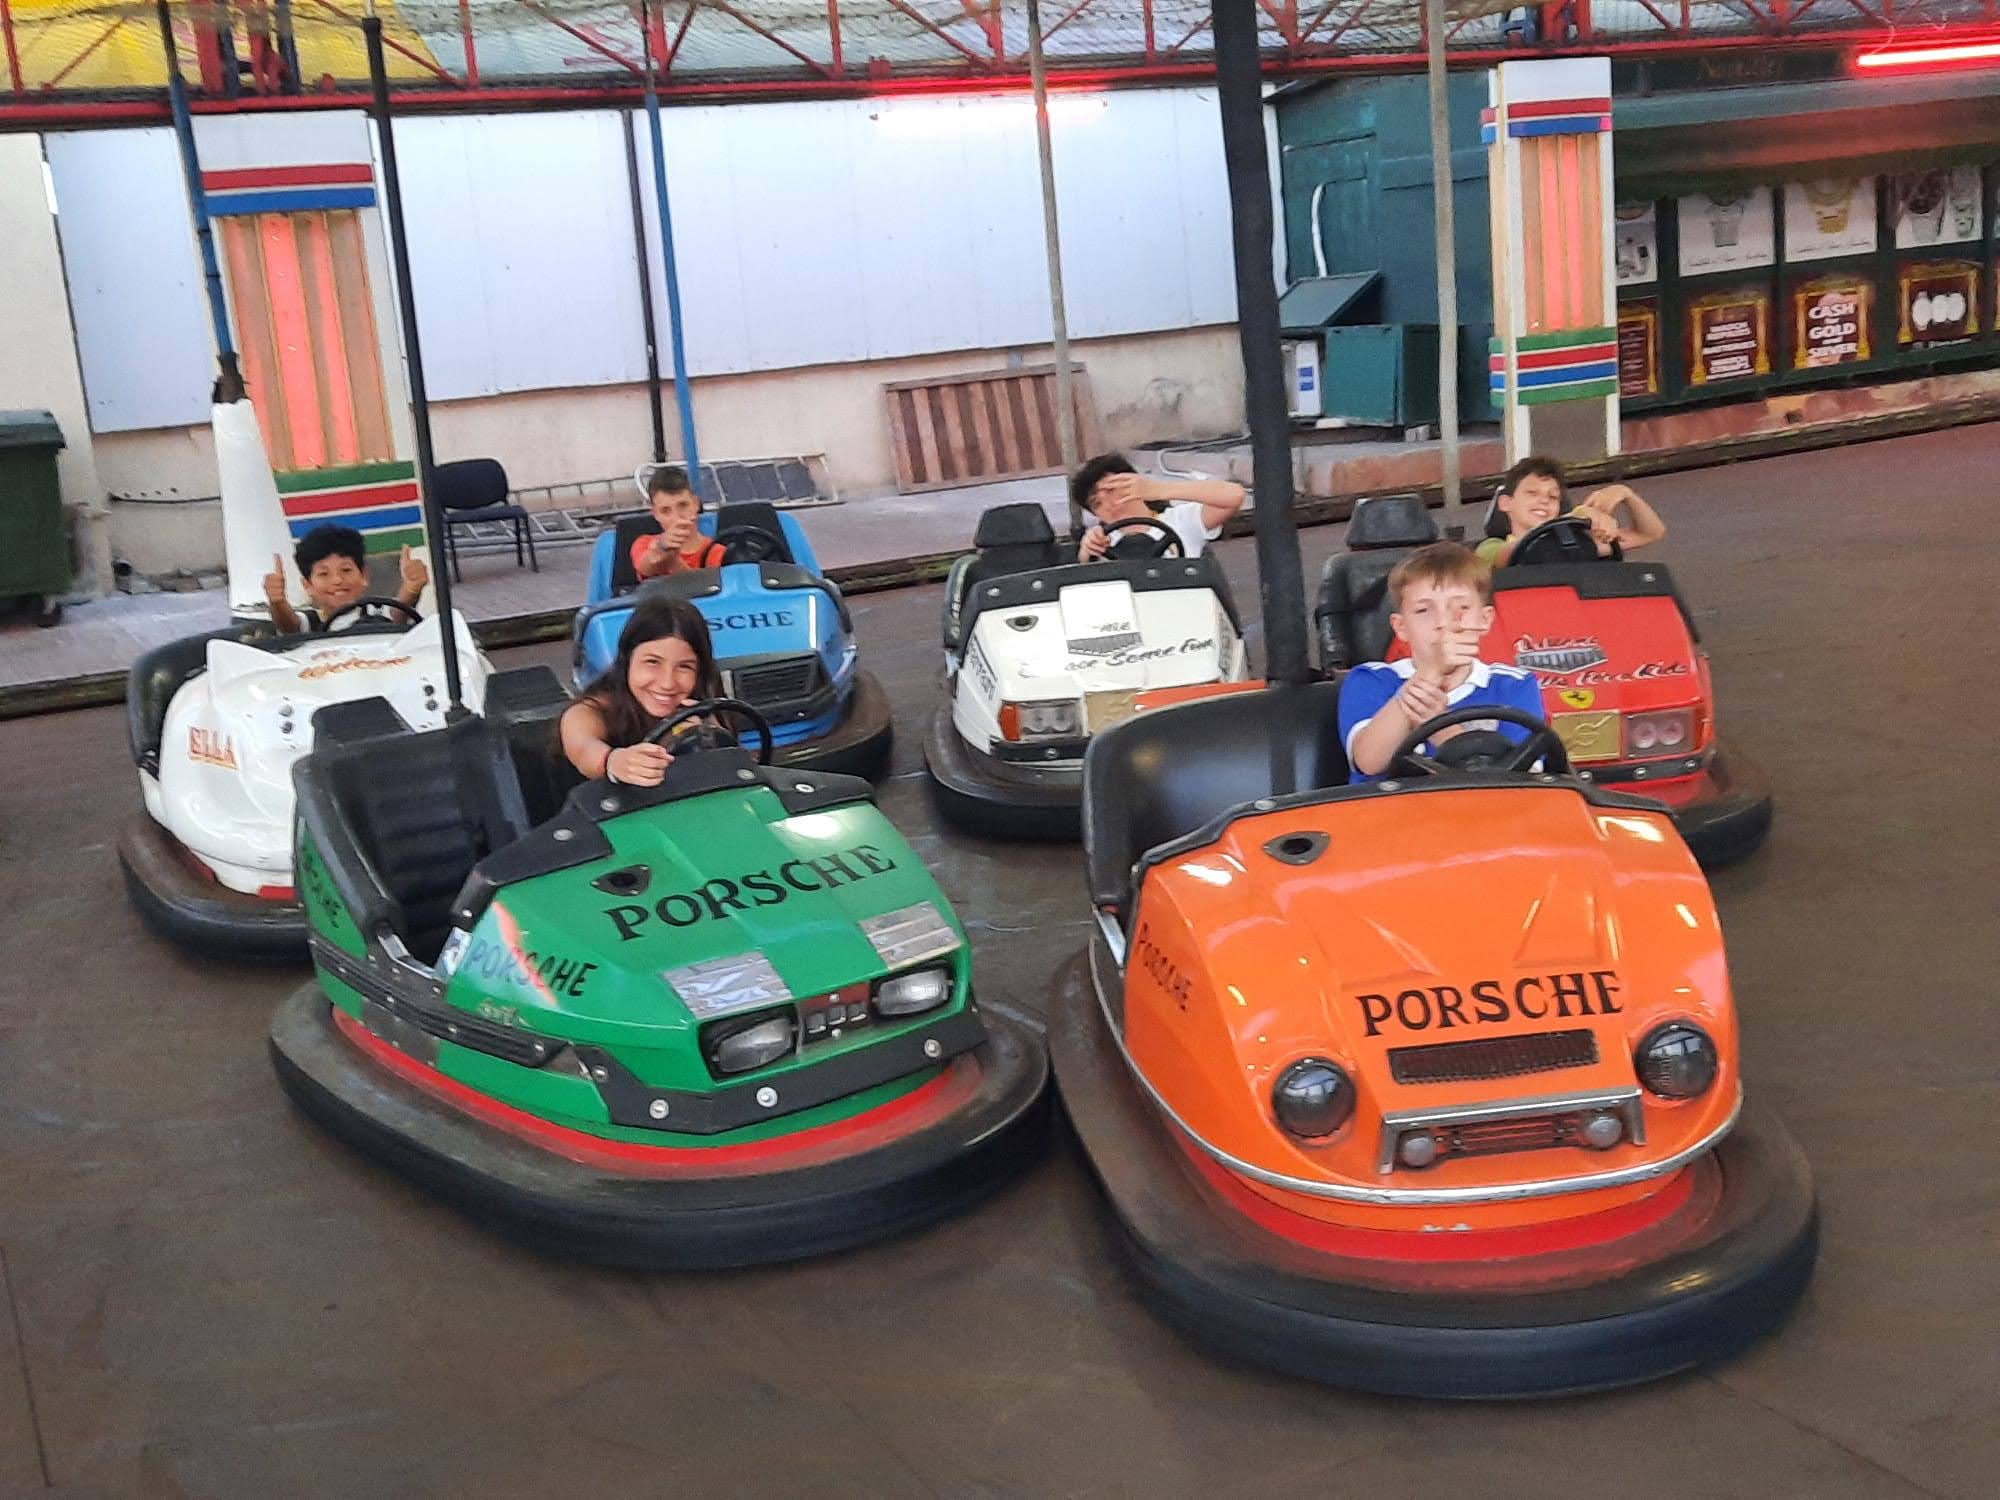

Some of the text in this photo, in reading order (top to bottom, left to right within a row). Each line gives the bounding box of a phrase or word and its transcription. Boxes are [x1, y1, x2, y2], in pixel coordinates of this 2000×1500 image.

[1809, 302, 1856, 319] CASH
[1809, 322, 1856, 339] GOLD
[602, 845, 898, 940] PORSCHE
[464, 938, 599, 997] PORSCHE
[1355, 970, 1626, 1037] PORSCHE
